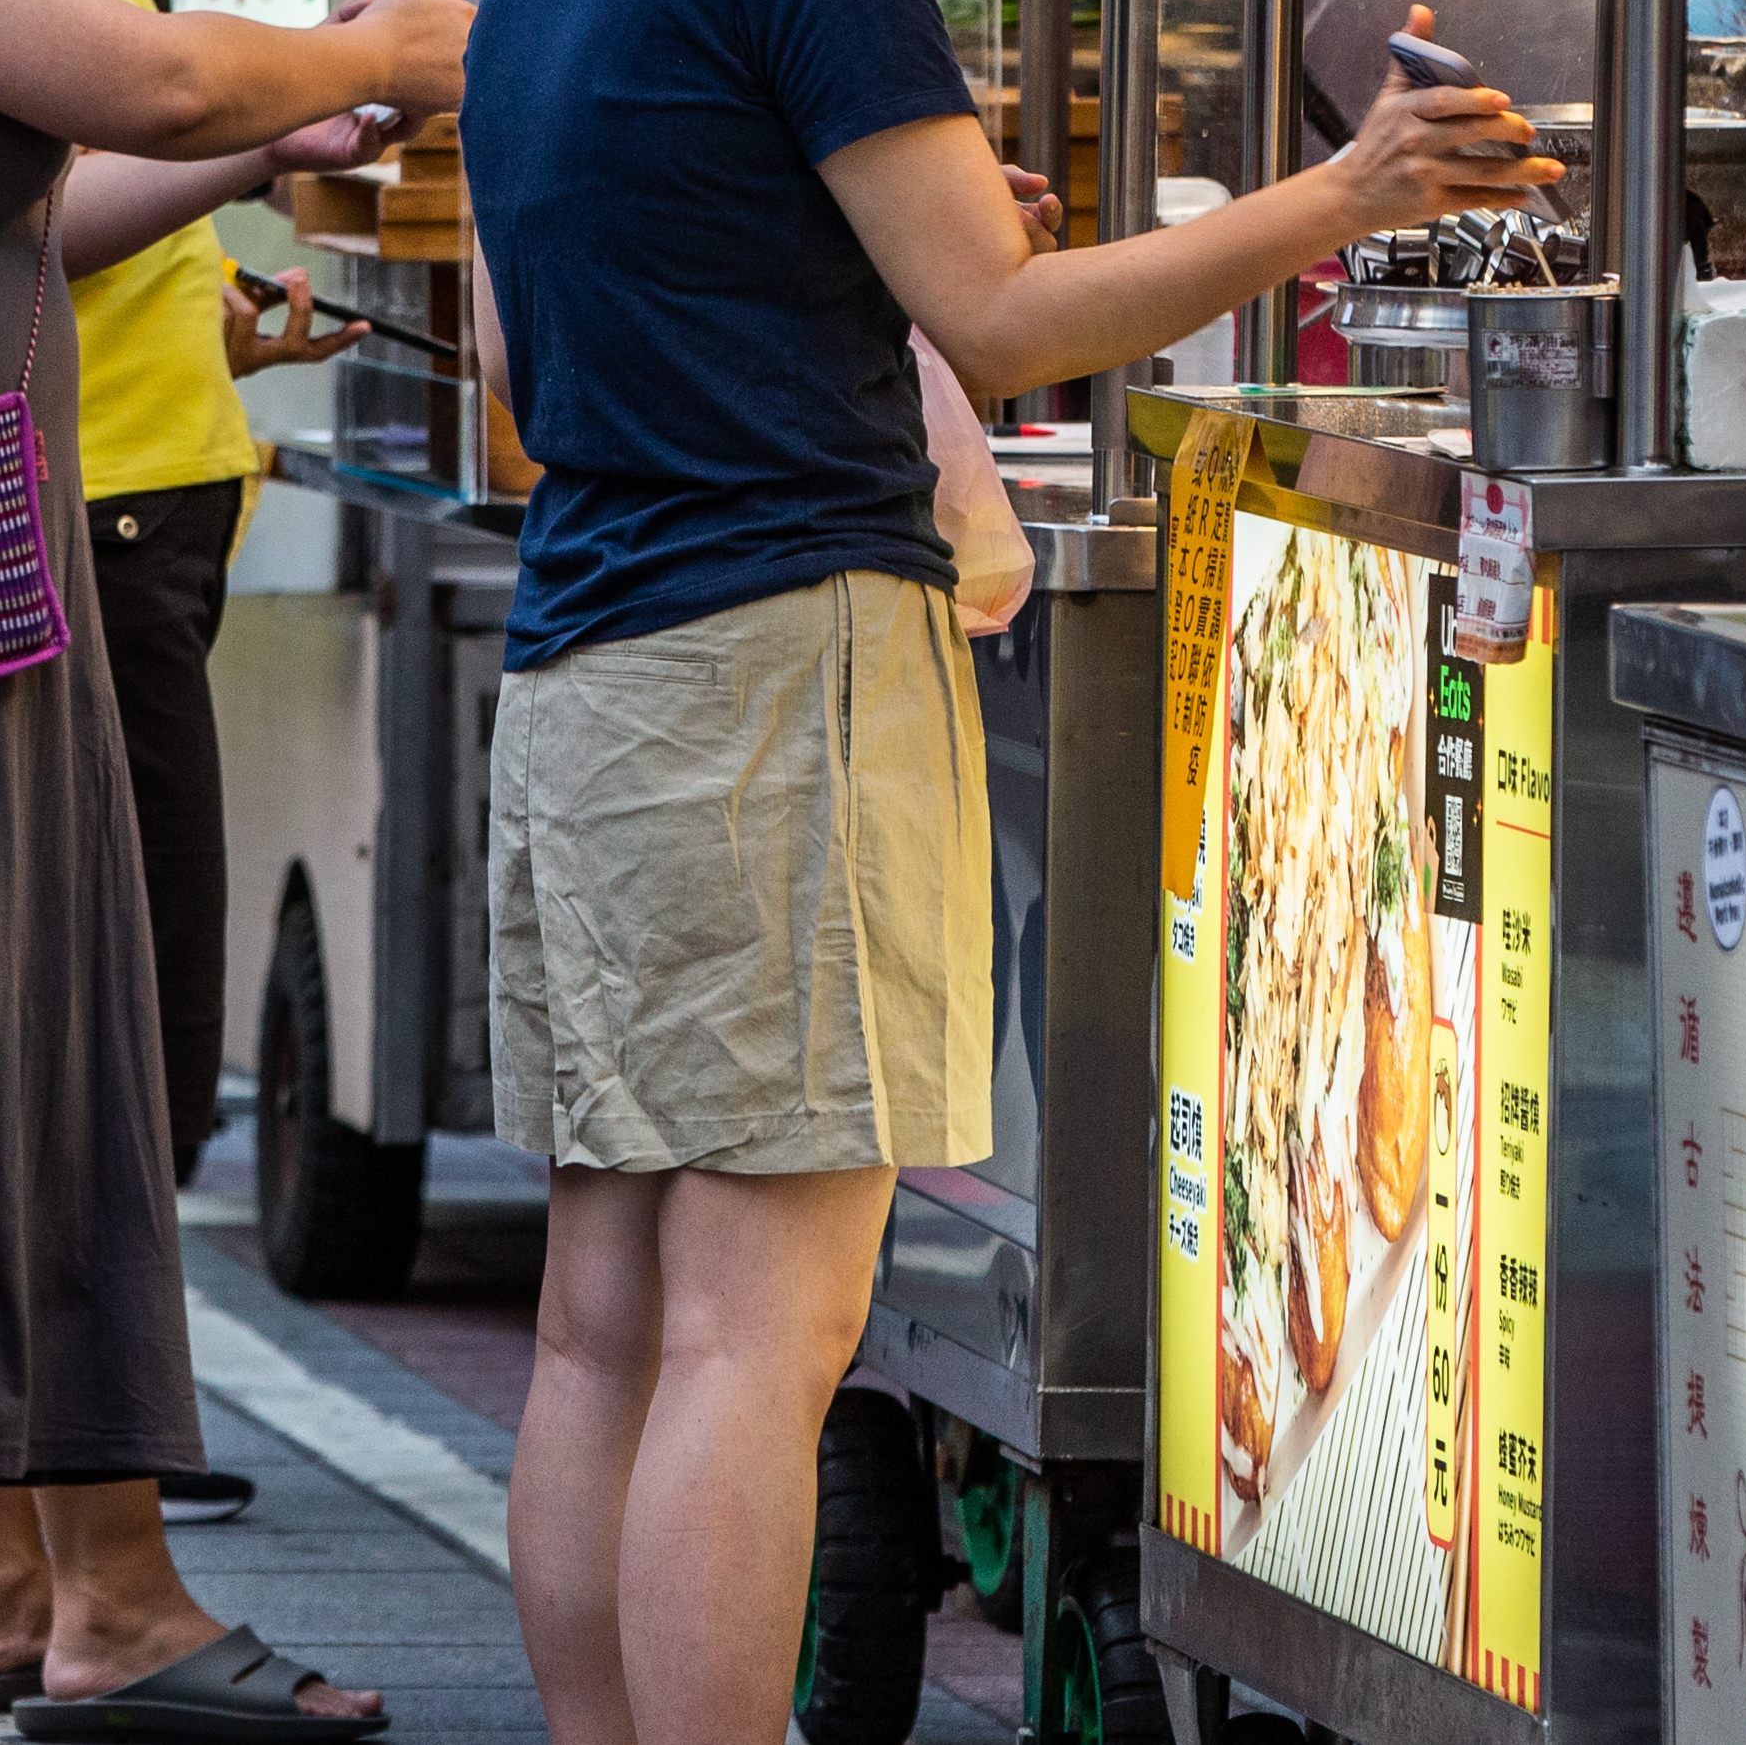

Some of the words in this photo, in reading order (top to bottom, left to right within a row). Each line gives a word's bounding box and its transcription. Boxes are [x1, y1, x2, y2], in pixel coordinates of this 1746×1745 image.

[1174, 445, 1220, 731] QRCODE
[1439, 664, 1472, 722] Eats
[1437, 733, 1473, 783] 合作餐廳
[1498, 749, 1519, 797] 口味
[1502, 908, 1532, 956] 哇沙米
[1501, 962, 1524, 989] Wasabi
[1170, 1090, 1203, 1162] 起司燒
[1500, 1079, 1540, 1136] 招牌醬燒
[1500, 1135, 1525, 1165] Teriyaki
[1169, 1165, 1207, 1212] Cheeseyaki
[1499, 1254, 1538, 1311] 香香辣辣
[1498, 1309, 1516, 1342] Spicy
[1498, 1428, 1538, 1486] 蜂蜜芥末
[1498, 1483, 1517, 1518] Honey
